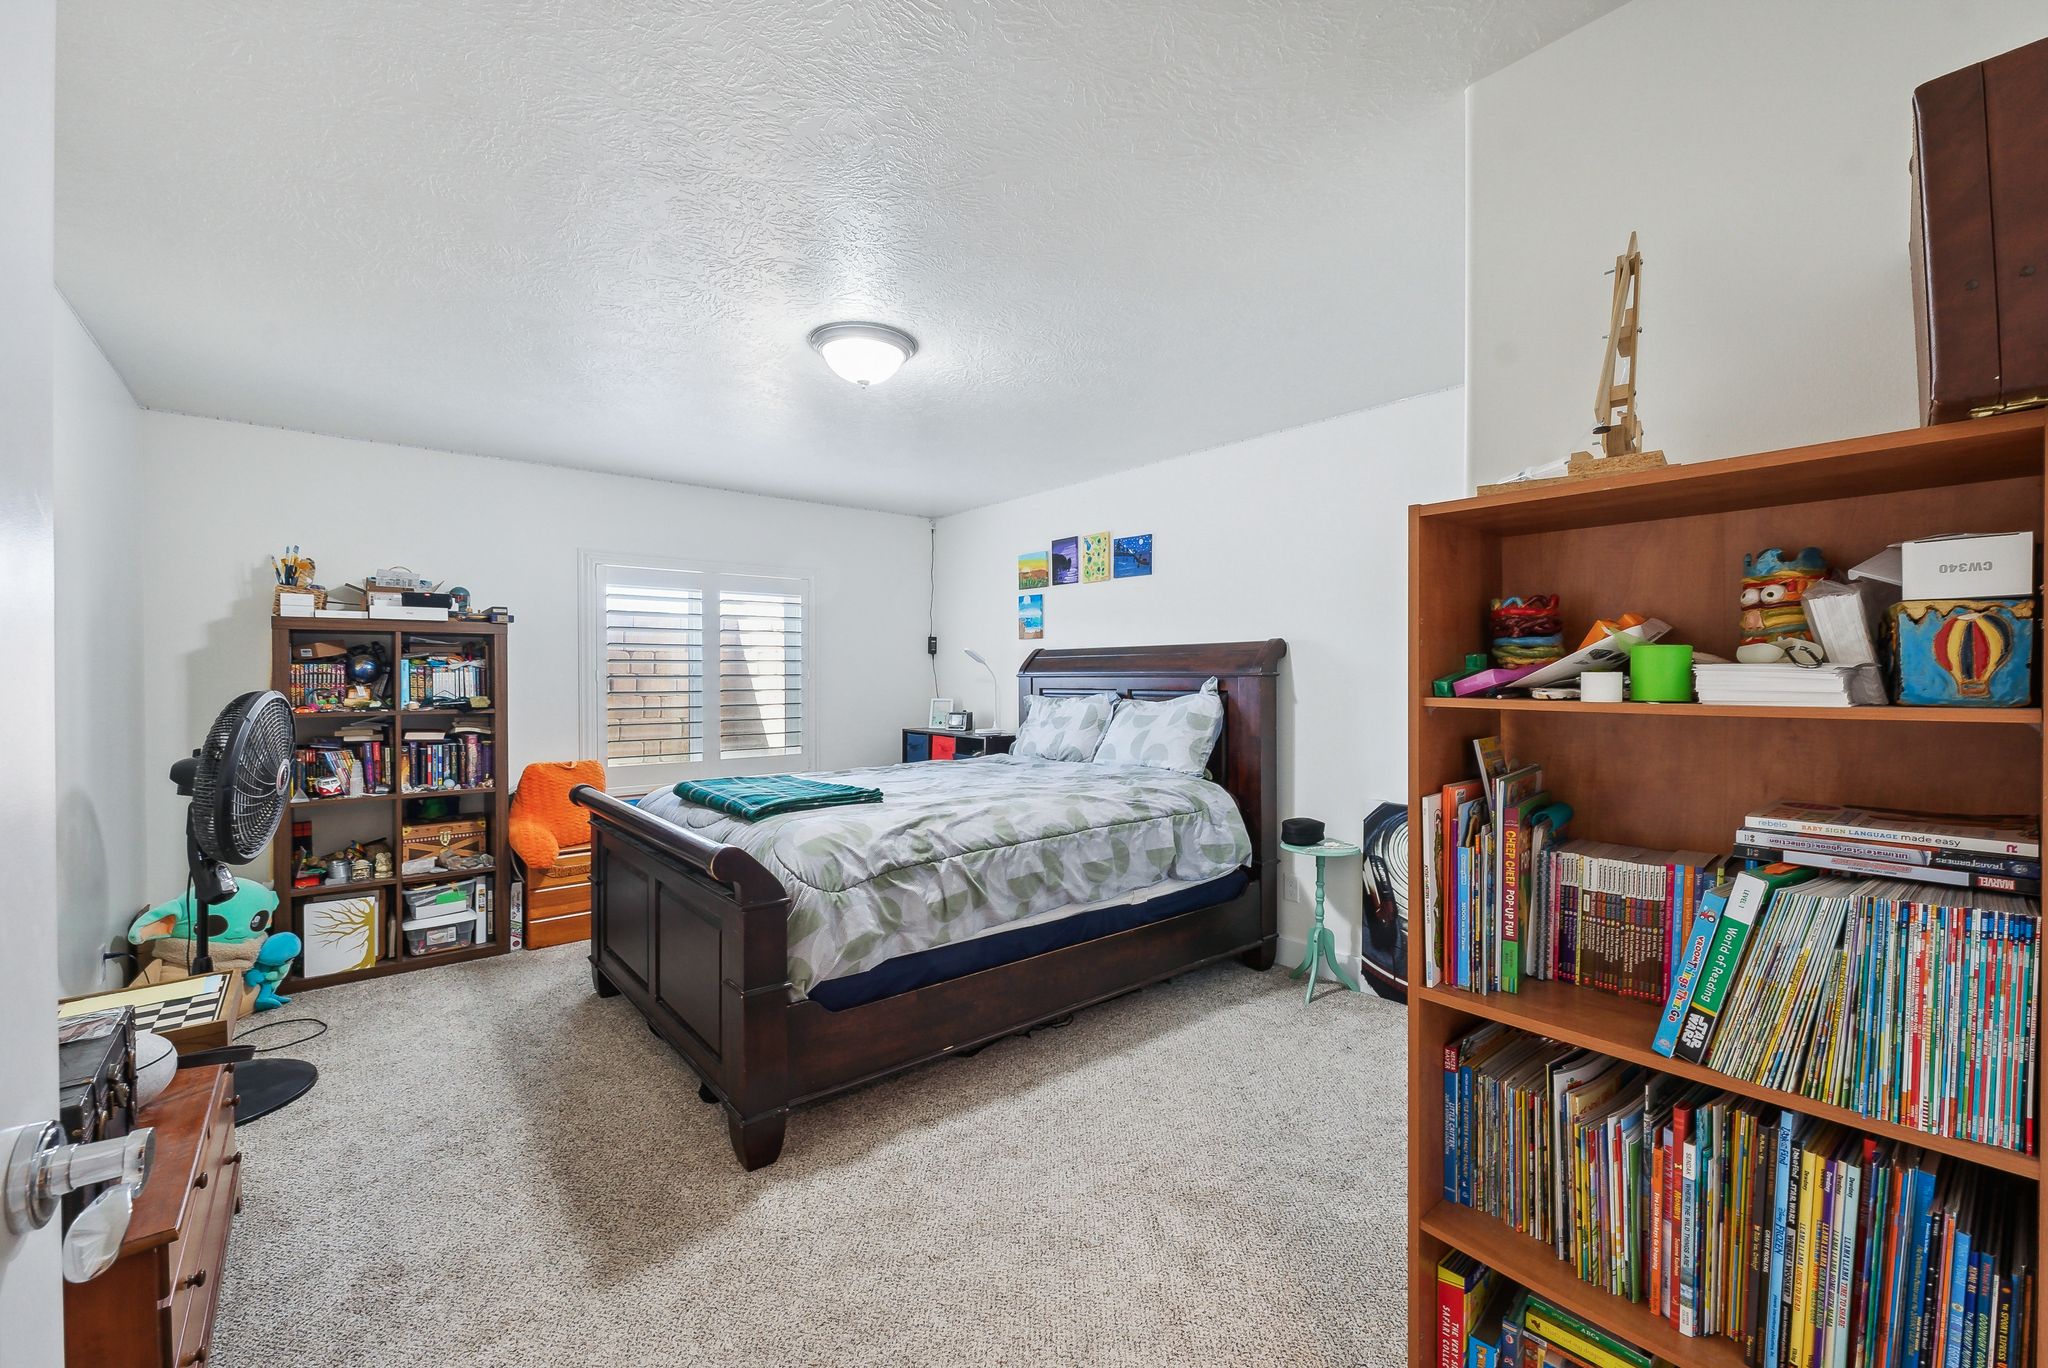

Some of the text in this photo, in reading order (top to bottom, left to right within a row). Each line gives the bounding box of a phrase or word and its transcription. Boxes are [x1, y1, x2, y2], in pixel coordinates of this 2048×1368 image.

[1939, 561, 1993, 574] CW340
[1758, 820, 1788, 828] rebelo
[1506, 831, 1517, 859] CHEEP
[1769, 838, 1909, 860] Ultimate Storybook Collection
[1848, 830, 1898, 840] LANGUAGE
[1901, 834, 1932, 844] made
[1934, 837, 1961, 848] easy
[1506, 861, 1517, 887] CHEEP
[1978, 876, 2016, 890] MARVEL
[1506, 889, 1517, 919] POP-UP
[1740, 889, 1750, 902] LEVEL
[1506, 921, 1518, 937] FUN
[1720, 927, 1738, 952] World
[1693, 936, 1706, 962] VROOM
[1716, 954, 1726, 966] of
[1680, 960, 1698, 989] Things
[1702, 966, 1724, 1003] Reading
[1672, 990, 1687, 1009] That
[1669, 1010, 1680, 1022] Go
[1682, 1013, 1700, 1048] WARS
[1690, 1016, 1708, 1048] STAR
[1779, 1149, 1788, 1166] Find
[1824, 1171, 1832, 1192] Dewdney
[1835, 1174, 1843, 1195] Dewdney
[1847, 1177, 1855, 1199] Dewdney
[1774, 1223, 1785, 1256] FROZEN
[1821, 1223, 1829, 1244] LLAMA
[1831, 1230, 1839, 1251] LLAMA
[1820, 1245, 1828, 1267] LLAMA
[1842, 1237, 1851, 1260] LLAMA
[1830, 1252, 1838, 1273] LLAMA
[1841, 1260, 1850, 1280] LLAMA
[1795, 1286, 1802, 1294] TO
[1828, 1274, 1836, 1291] HOME
[1840, 1299, 1847, 1307] TO
[1816, 1300, 1824, 1328] GRANDPA
[1826, 1308, 1834, 1327] MAMA
[1838, 1308, 1846, 1328] SHARE
[2000, 1312, 2009, 1334] SPOOKY
[1964, 1320, 1973, 1349] RUNAWAY
[1978, 1313, 1988, 1351] GOODNIGHT
[1791, 1348, 1799, 1362] Viking
[1998, 1335, 2008, 1361] EXPRESS
